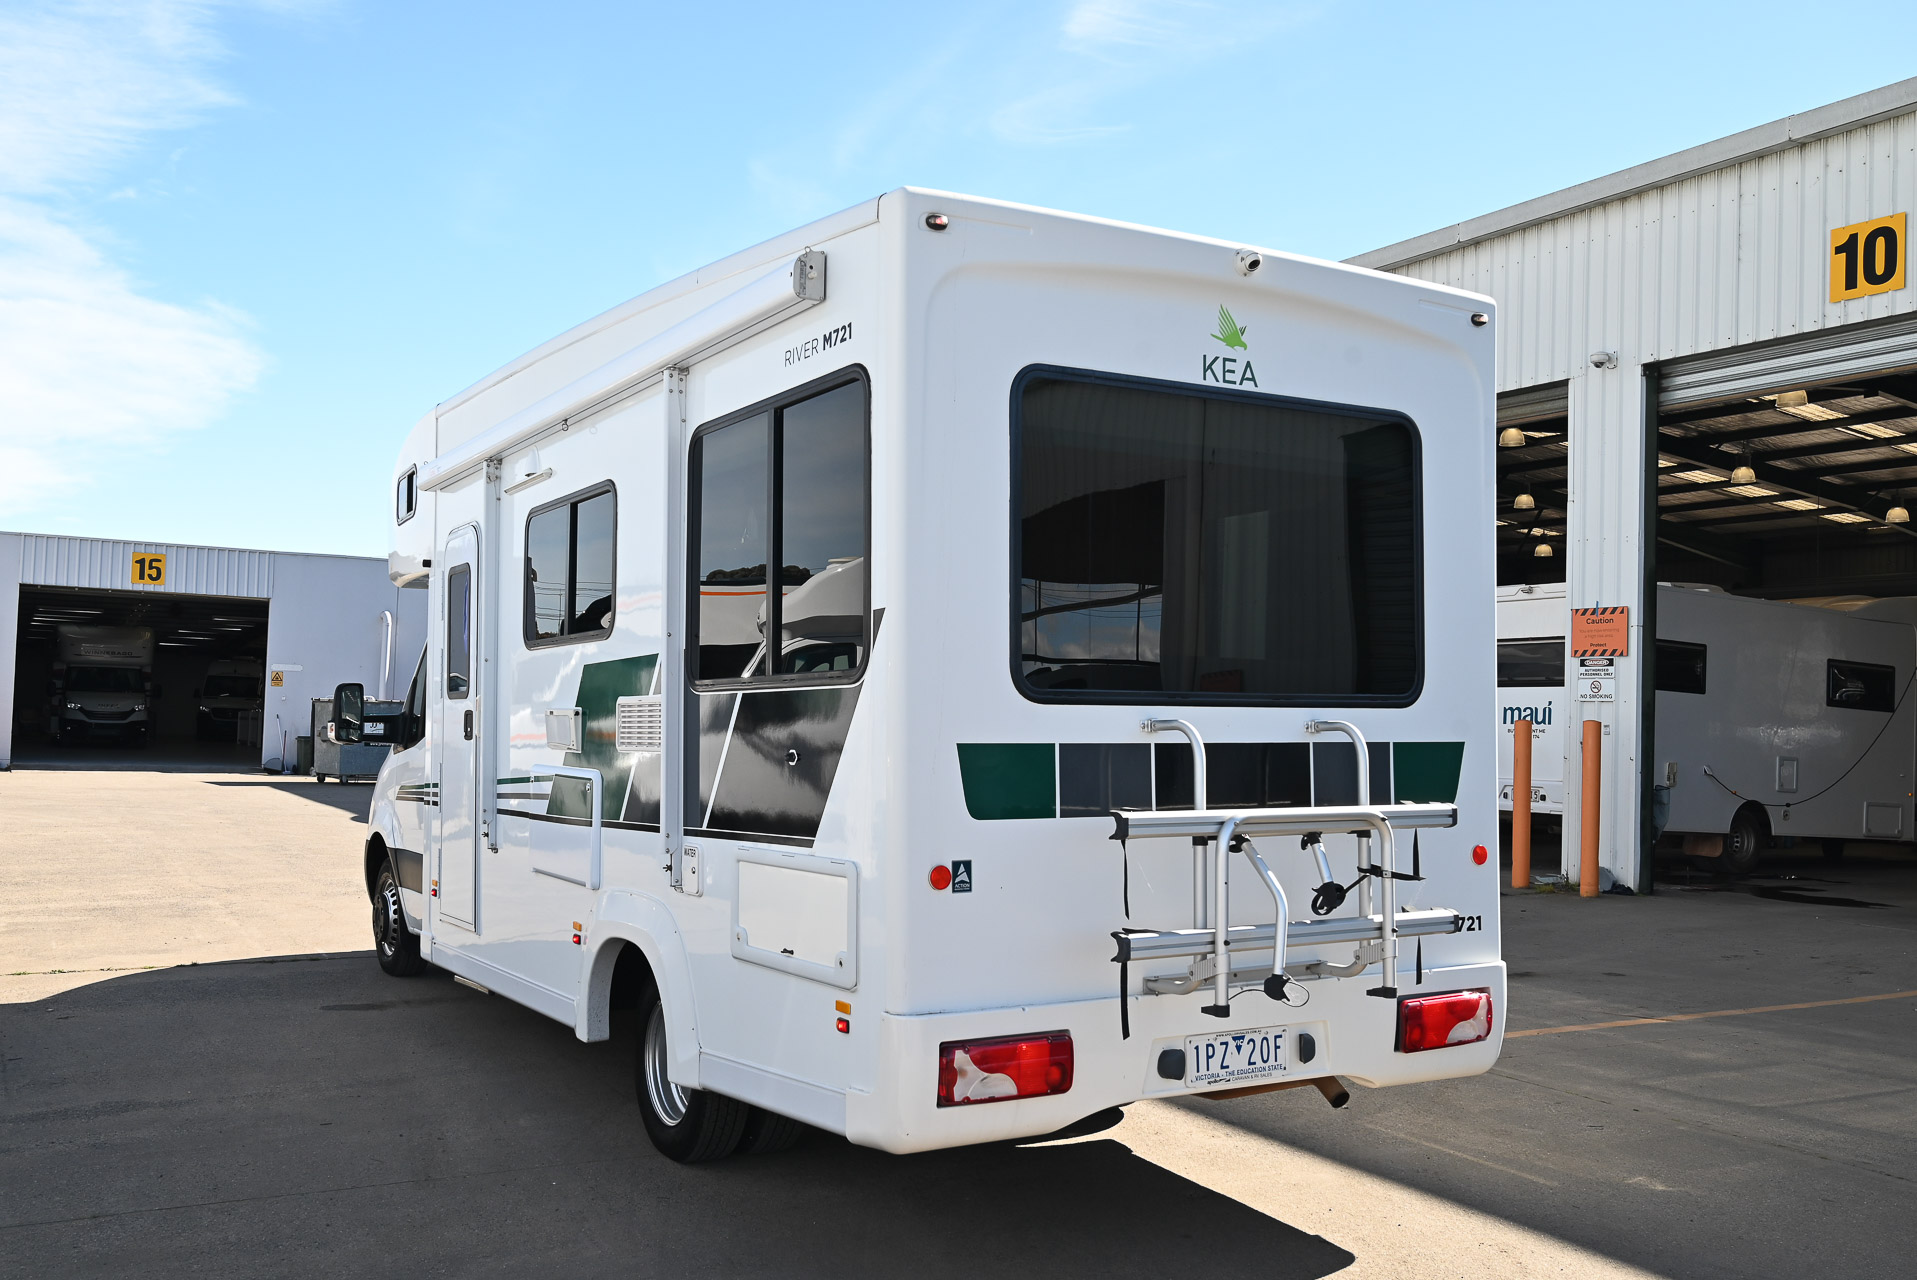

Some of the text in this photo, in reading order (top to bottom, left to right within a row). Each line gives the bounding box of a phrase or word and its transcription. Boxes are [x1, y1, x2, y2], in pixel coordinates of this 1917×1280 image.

[1834, 225, 1898, 291] 10
[784, 321, 852, 368] RIVER M721
[1202, 354, 1259, 388] KEA
[134, 557, 162, 581] 15
[1585, 617, 1614, 625] Caution
[684, 848, 696, 858] WATER
[1194, 1034, 1283, 1073] 1PZ 20F
[1194, 1073, 1221, 1082] VICTORIA
[1236, 1066, 1266, 1075] EDUCATION
[1267, 1063, 1283, 1072] STATE
